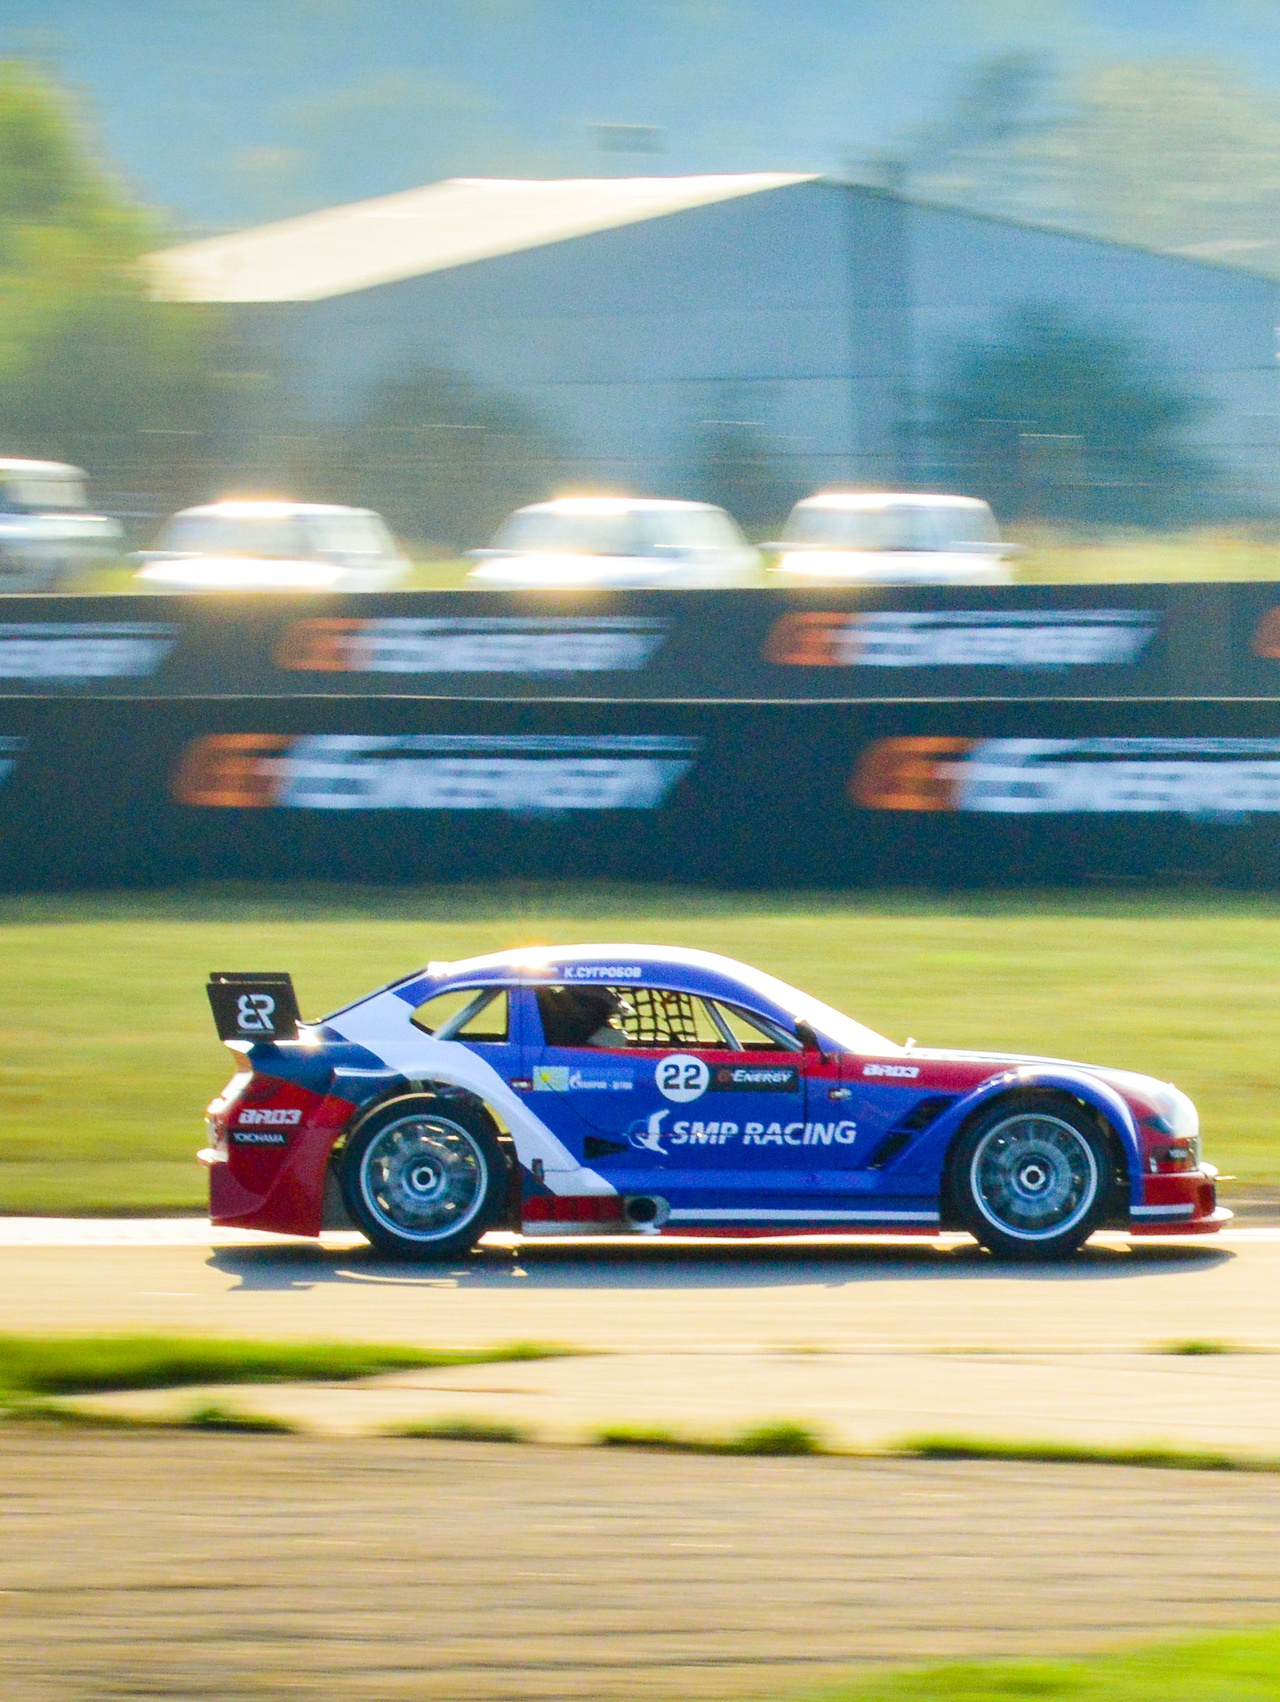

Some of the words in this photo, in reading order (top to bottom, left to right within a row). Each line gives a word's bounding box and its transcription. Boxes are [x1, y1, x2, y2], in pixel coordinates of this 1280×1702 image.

[662, 1064, 702, 1090] 22
[671, 1121, 739, 1145] SMP
[743, 1120, 857, 1145] RACING
